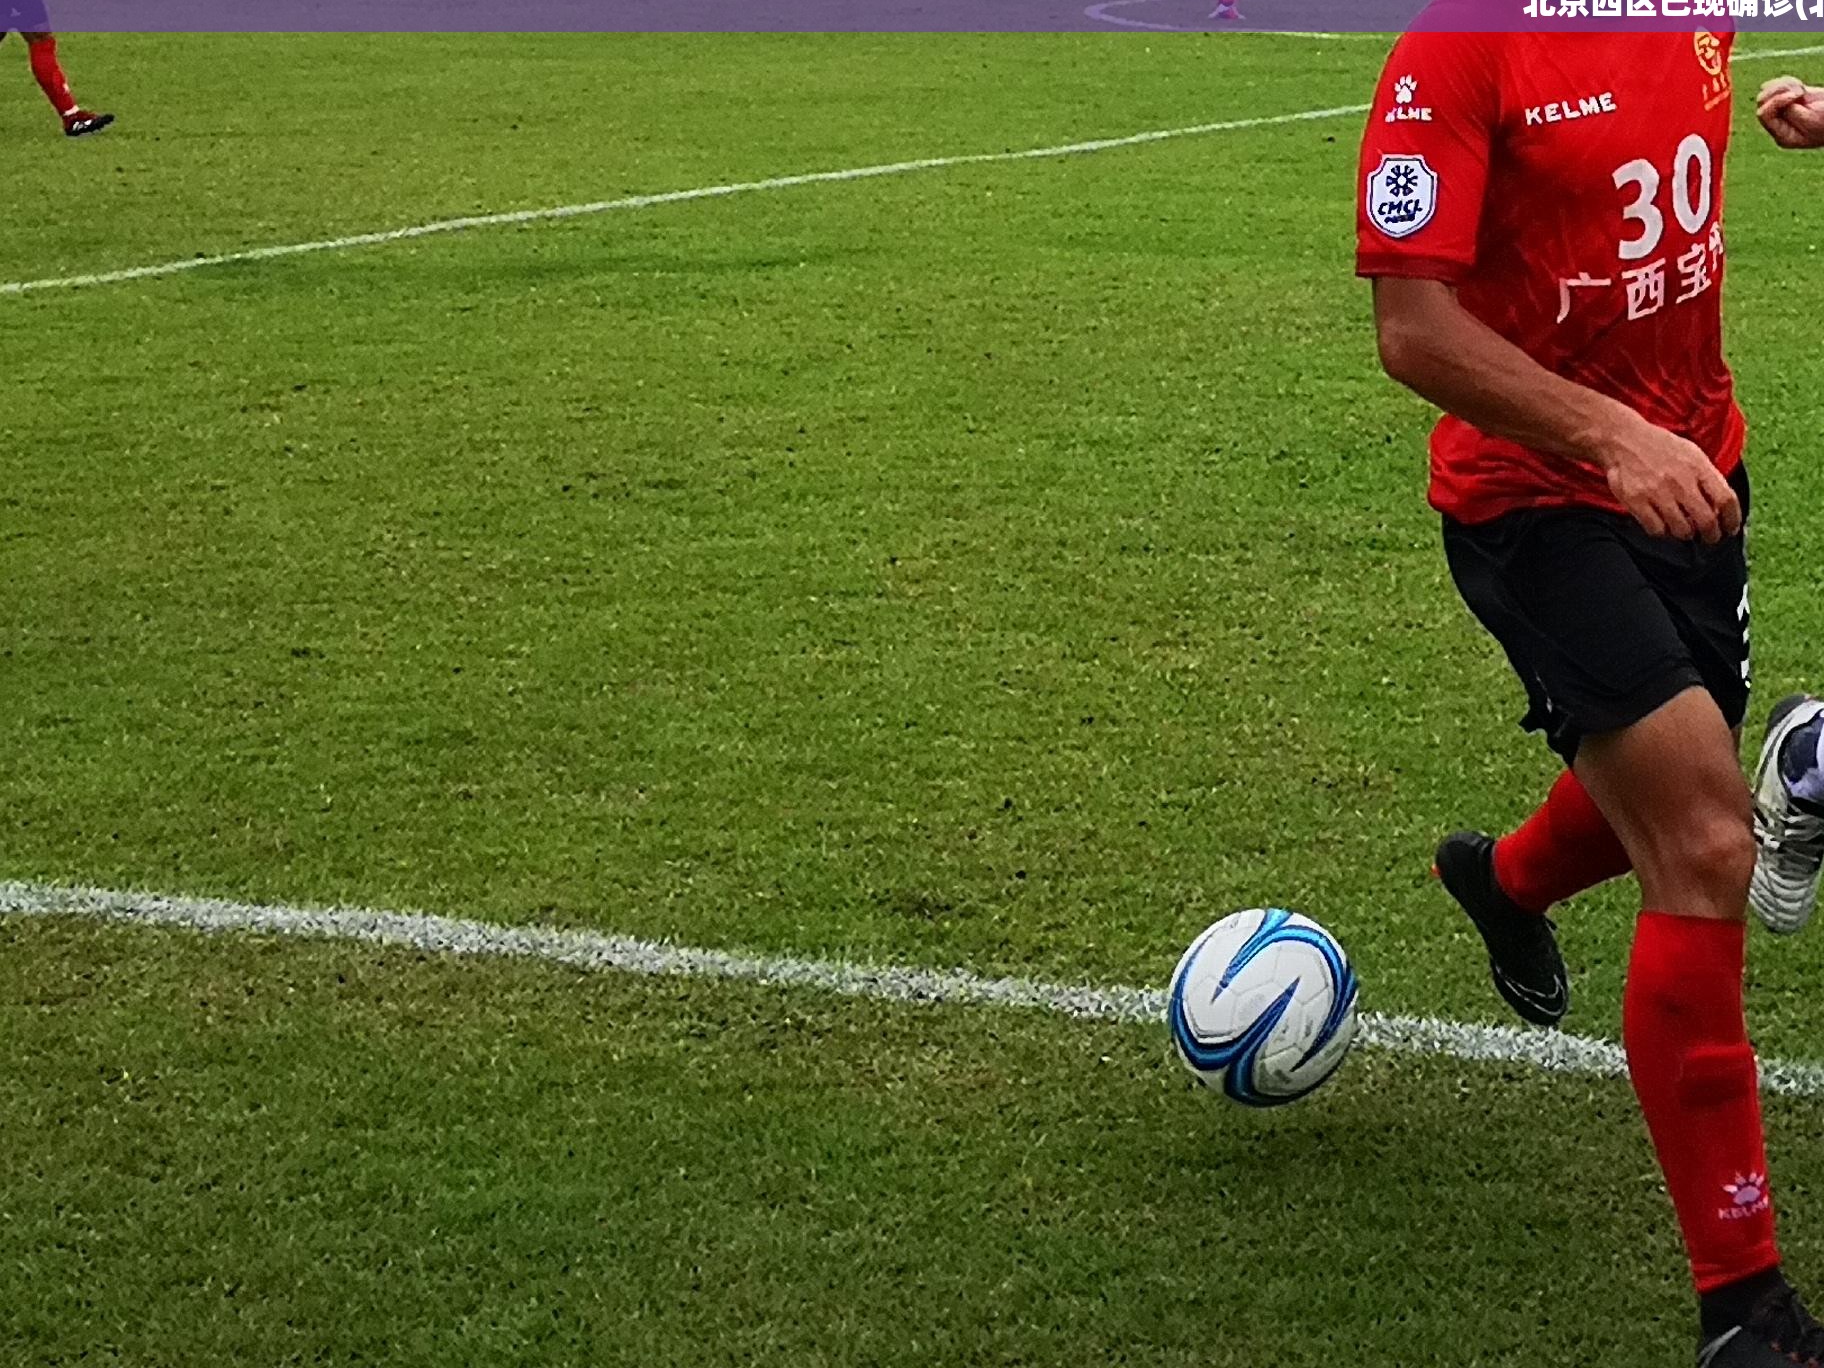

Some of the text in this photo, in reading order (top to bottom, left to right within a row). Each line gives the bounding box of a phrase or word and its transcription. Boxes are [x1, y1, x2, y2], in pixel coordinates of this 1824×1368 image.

[1524, 91, 1617, 126] KELME
[1377, 198, 1423, 216] CMCL
[1611, 133, 1712, 261] 30
